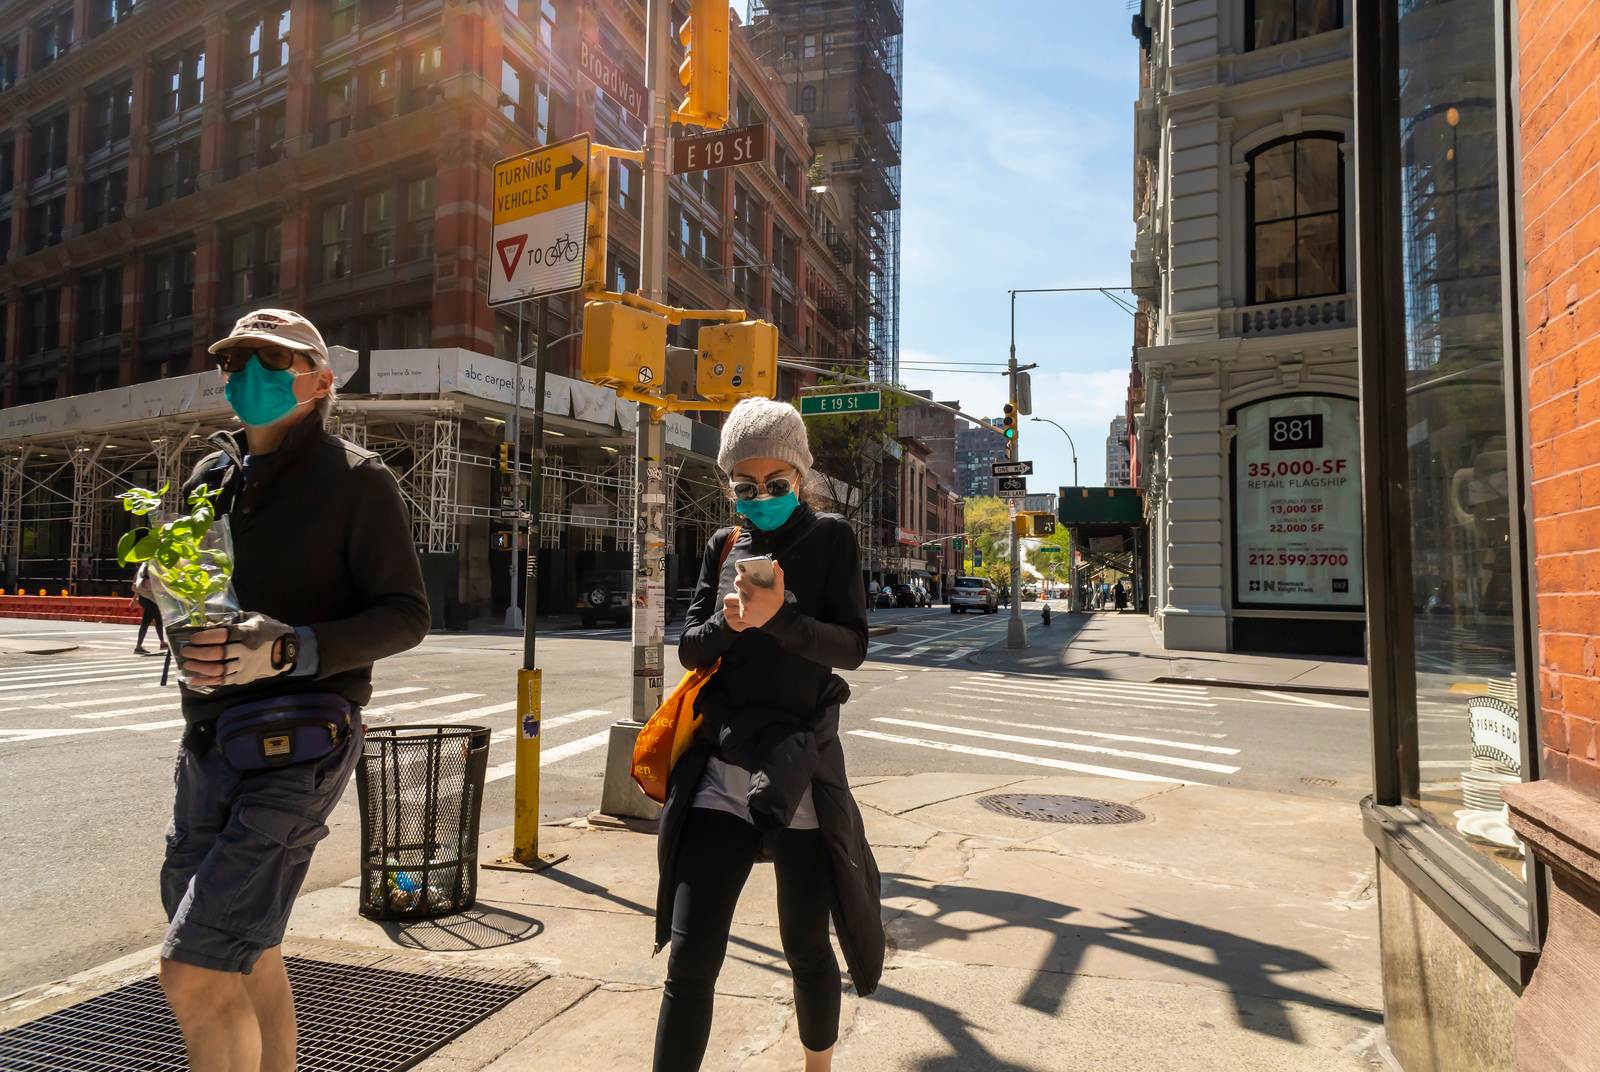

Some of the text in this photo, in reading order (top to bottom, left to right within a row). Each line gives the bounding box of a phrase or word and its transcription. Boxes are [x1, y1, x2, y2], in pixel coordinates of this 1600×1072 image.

[581, 41, 642, 117] Broadway
[687, 135, 752, 168] E 19 St
[498, 155, 552, 188] TURNING
[497, 186, 549, 213] VEHICLES
[527, 248, 542, 266] TO
[465, 363, 552, 398] abc carpet & hoe
[821, 396, 858, 410] E 19 St
[1273, 420, 1314, 442] 881
[1248, 459, 1348, 478] 35,000-SF
[1248, 477, 1347, 489] RETAIL FLAGSHIP
[1270, 504, 1324, 514] 13,000 SF
[1269, 523, 1324, 533] 22,000 SF
[1248, 554, 1348, 566] 212.599.3700
[1476, 719, 1498, 733] FISHS
